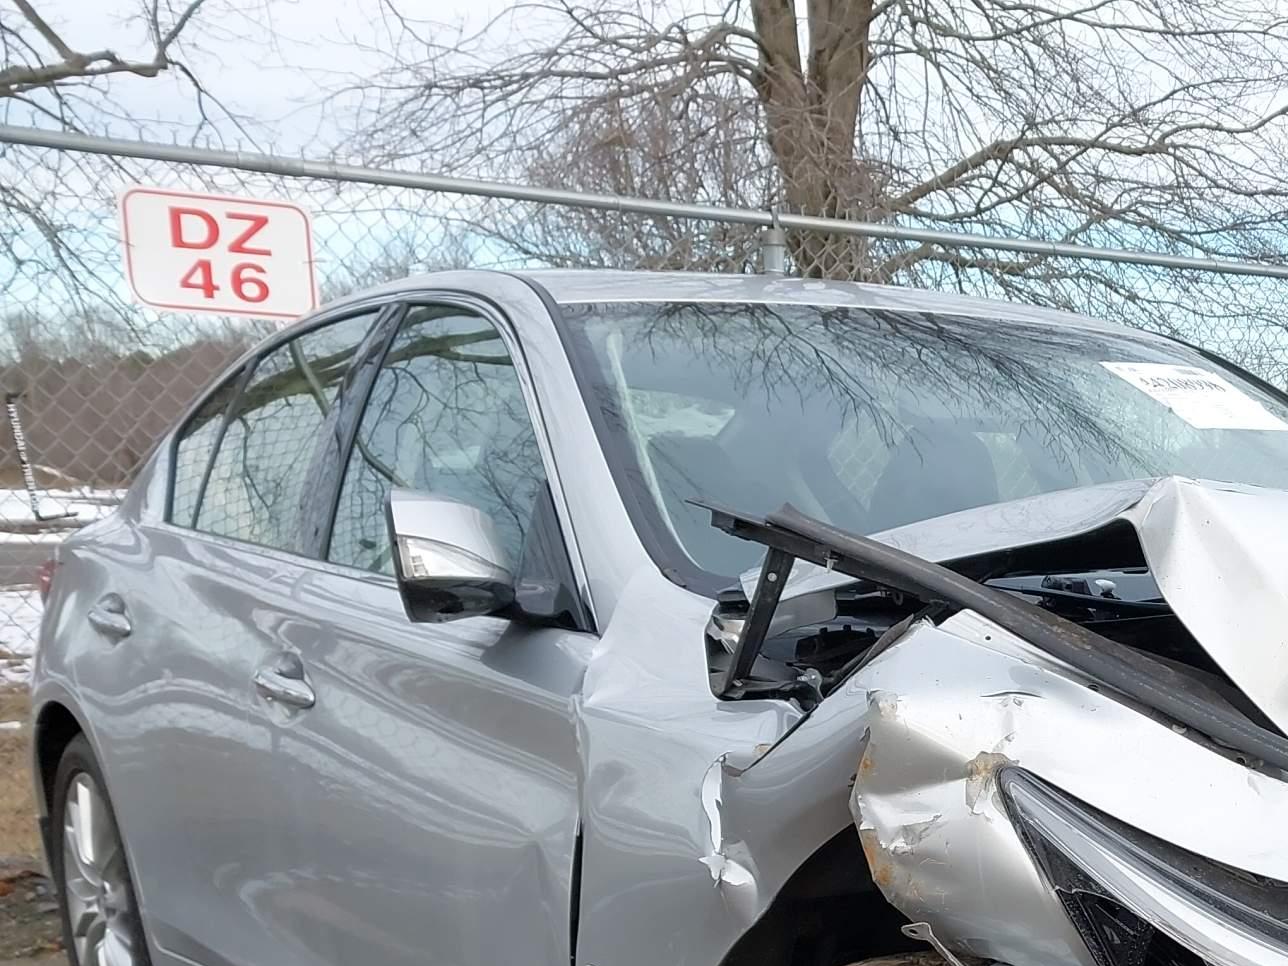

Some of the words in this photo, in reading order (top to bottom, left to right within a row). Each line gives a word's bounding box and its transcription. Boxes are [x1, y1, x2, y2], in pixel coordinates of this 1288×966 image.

[169, 207, 272, 256] DZ
[181, 259, 270, 303] 46
[7, 404, 26, 451] HYUNDAI
